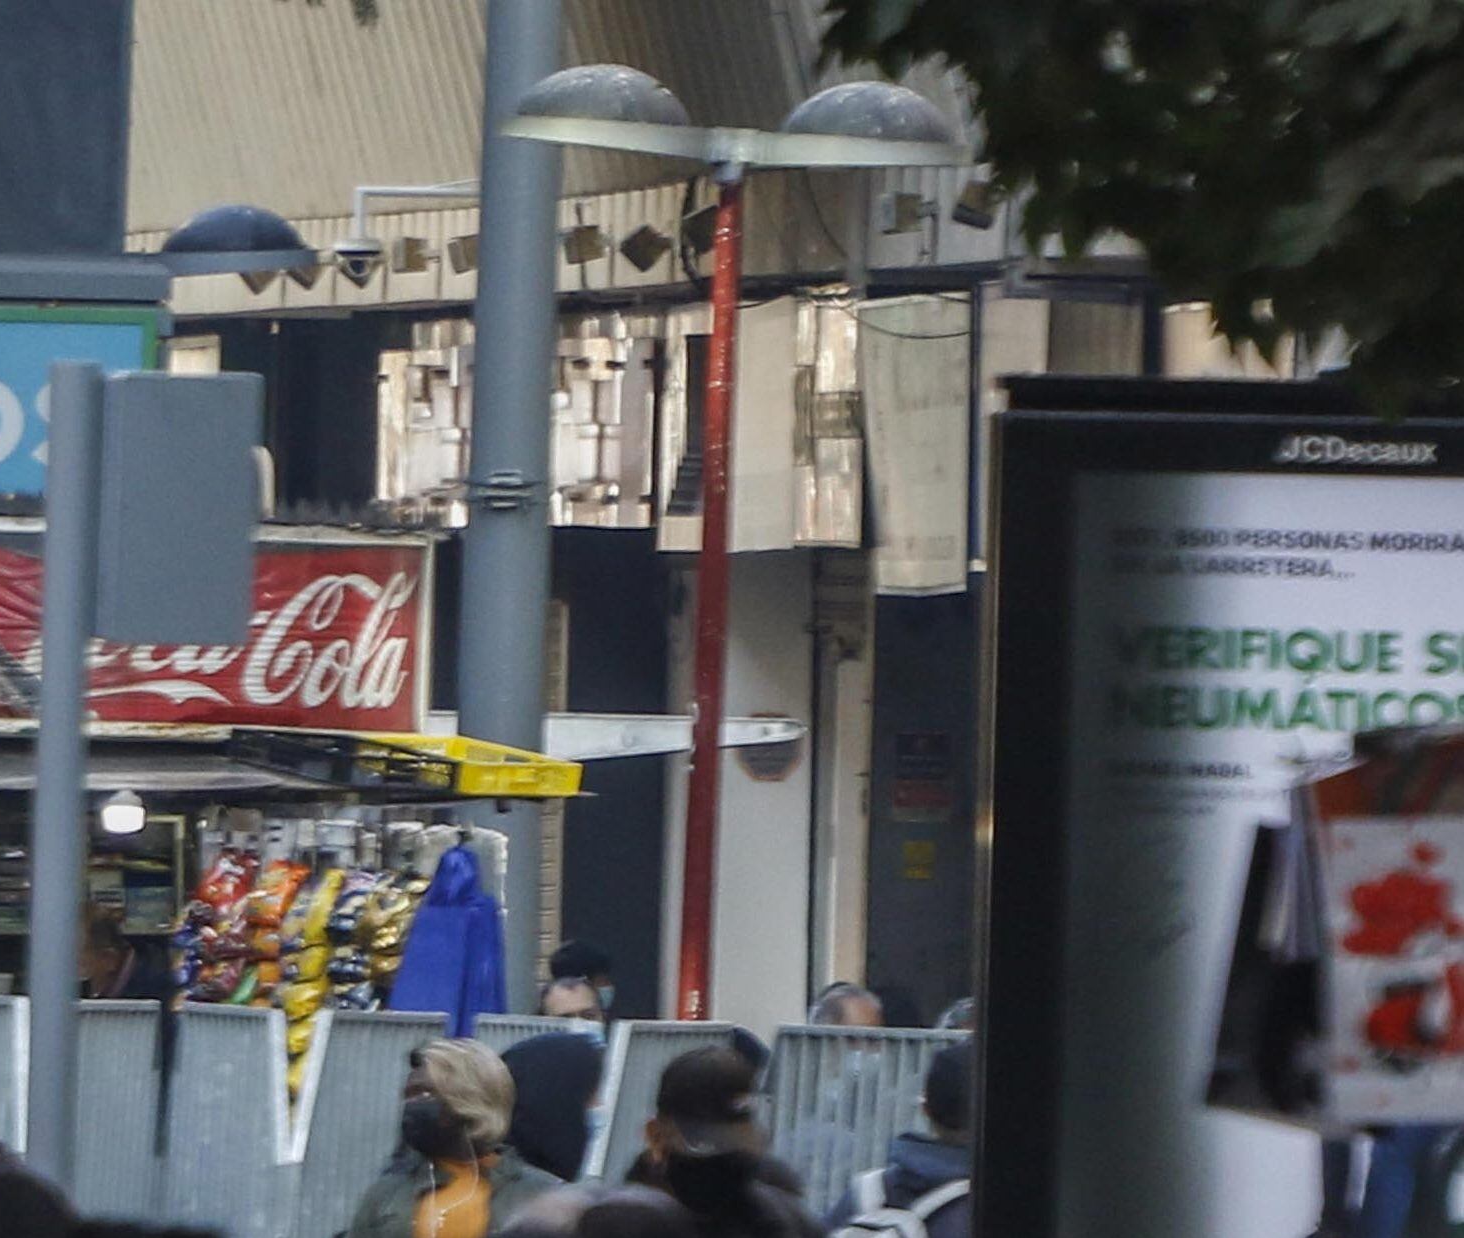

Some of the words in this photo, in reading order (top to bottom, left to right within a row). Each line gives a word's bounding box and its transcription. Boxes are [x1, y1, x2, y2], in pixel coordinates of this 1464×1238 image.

[1276, 434, 1438, 464] JCDecaux
[1234, 528, 1364, 551] PERSONAS
[1115, 626, 1402, 674] VERIFIQUE
[1425, 631, 1464, 675] S
[1111, 677, 1464, 732] NEUMÁTICO
